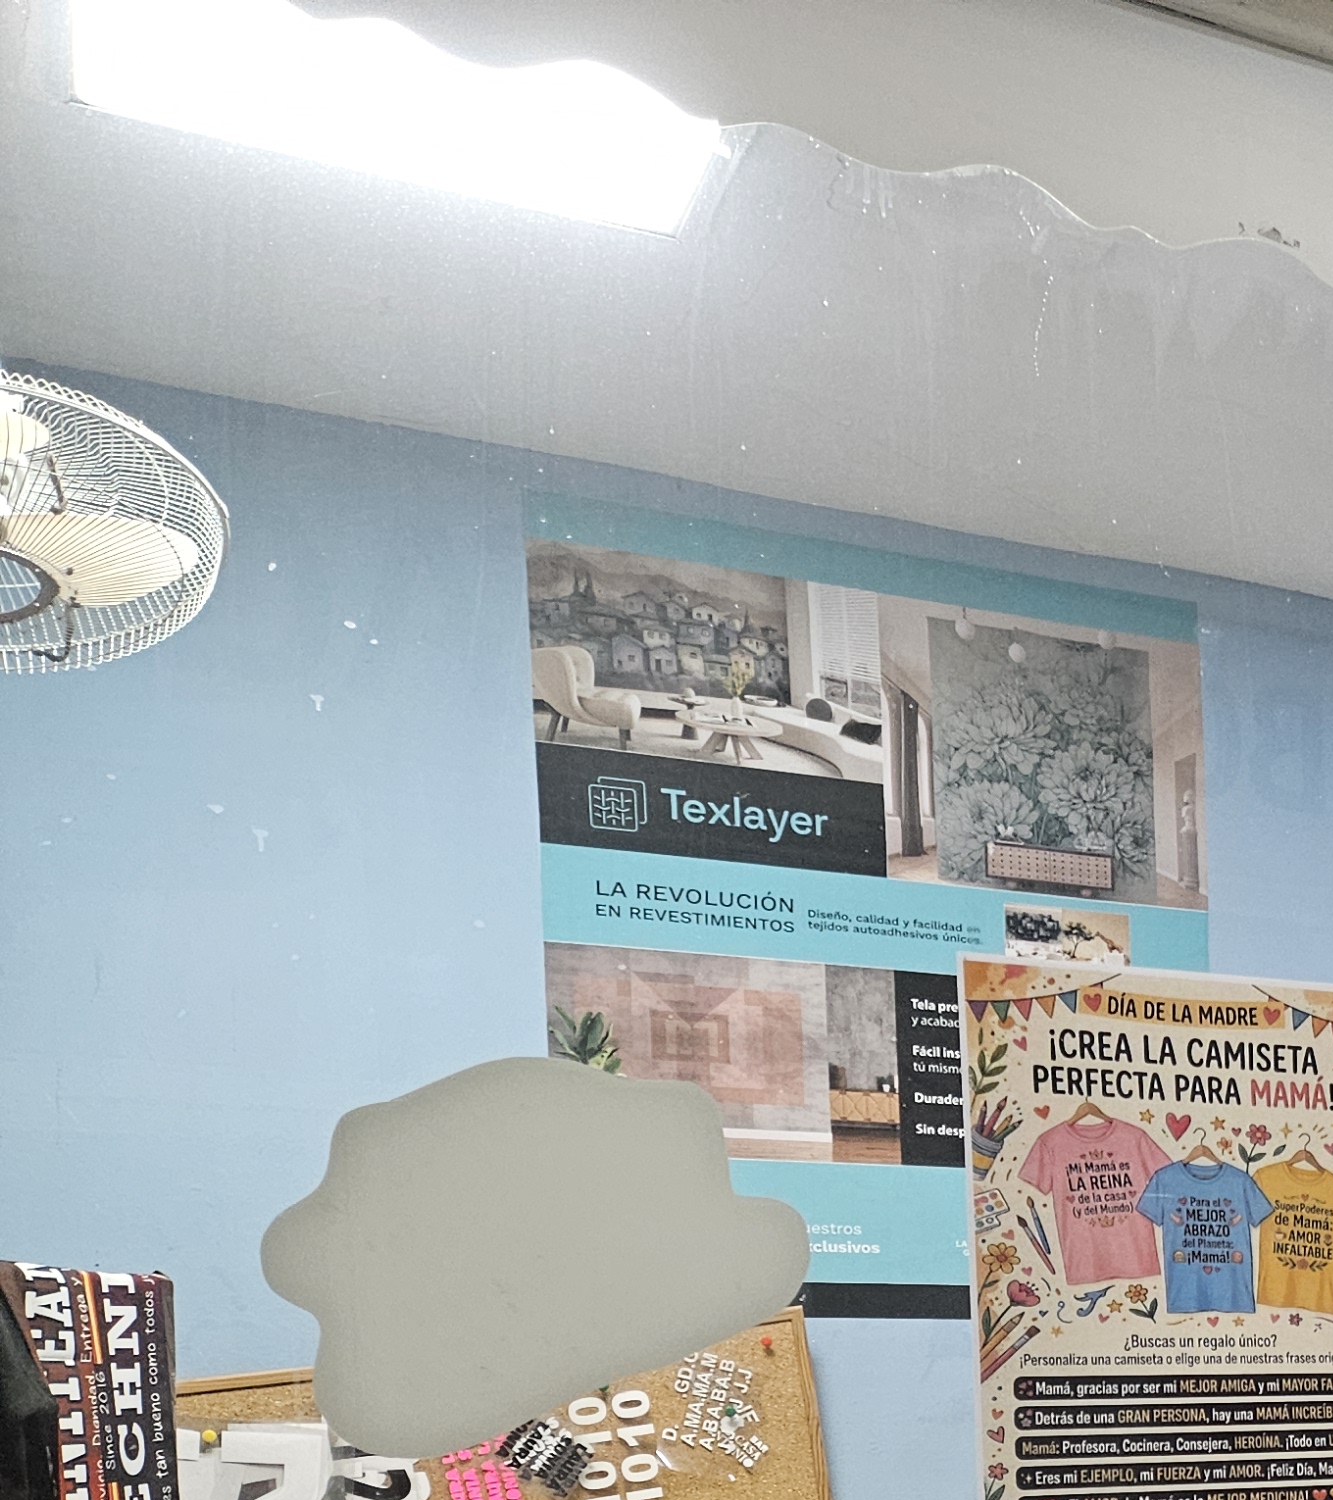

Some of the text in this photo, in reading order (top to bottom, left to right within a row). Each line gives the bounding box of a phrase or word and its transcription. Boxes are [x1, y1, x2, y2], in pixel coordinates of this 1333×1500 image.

[660, 787, 828, 843] Texlayer
[595, 879, 796, 914] LA REVOLUCIÓN
[595, 903, 795, 934] EN REVESTIMIENTOS
[807, 908, 853, 923] Diseño,
[855, 913, 900, 928] calidad
[902, 918, 910, 929] y
[912, 918, 964, 933] facilidad
[807, 920, 850, 936] tejidos
[853, 923, 939, 942] autoadhesivos
[910, 998, 936, 1012] Tela
[1107, 994, 1258, 1027] DÍA DE LA MADRE
[911, 1044, 940, 1059] Fácil
[1049, 1028, 1318, 1074] ¡CREA LA CAMISETA
[1033, 1065, 1165, 1101] PERFECTA
[1175, 1074, 1241, 1105] PARA
[915, 1123, 935, 1137] Sin
[145, 1291, 155, 1335] todos
[79, 1293, 92, 1364] Entrega
[1124, 1333, 1277, 1351] ¿Buscas un regalo único?
[147, 1342, 158, 1386] como
[1019, 1353, 1088, 1368] ¡Personaliza
[1091, 1355, 1111, 1365] una
[1114, 1353, 1163, 1365] camiseta
[1166, 1355, 1173, 1365] o
[1175, 1353, 1200, 1367] elige
[1203, 1354, 1223, 1364] una
[1225, 1353, 1237, 1364] de
[1240, 1353, 1284, 1364] nuestras
[1285, 1351, 1316, 1364] frases
[1035, 1381, 1074, 1397] Mamá,
[1076, 1380, 1119, 1398] gracias
[1121, 1382, 1140, 1397] por
[1143, 1382, 1160, 1394] ser
[1163, 1380, 1177, 1393] mi
[1180, 1378, 1218, 1394] MEJOR
[1220, 1378, 1256, 1393] AMIGA
[1257, 1381, 1265, 1394] y
[1266, 1378, 1280, 1392] mi
[1282, 1378, 1319, 1391] MAYOR
[96, 1371, 117, 1471] Since 2016
[150, 1392, 165, 1443] bueno
[1035, 1410, 1074, 1425] Detrás
[1076, 1411, 1091, 1424] de
[1093, 1412, 1114, 1424] una
[1117, 1410, 1150, 1423] GRAN
[1153, 1408, 1209, 1424] PERSONA,
[1212, 1408, 1231, 1424] hay
[1234, 1410, 1253, 1421] una
[1256, 1404, 1288, 1420] MAMÁ
[1022, 1441, 1060, 1455] Mamá:
[1062, 1440, 1120, 1454] Profesora,
[1122, 1438, 1174, 1453] Cocinera,
[1176, 1436, 1232, 1453] Consejera,
[1234, 1434, 1283, 1449] HEROÍNA.
[1285, 1434, 1312, 1450] ¡Todo
[1314, 1435, 1327, 1447] en
[156, 1450, 169, 1479] tan
